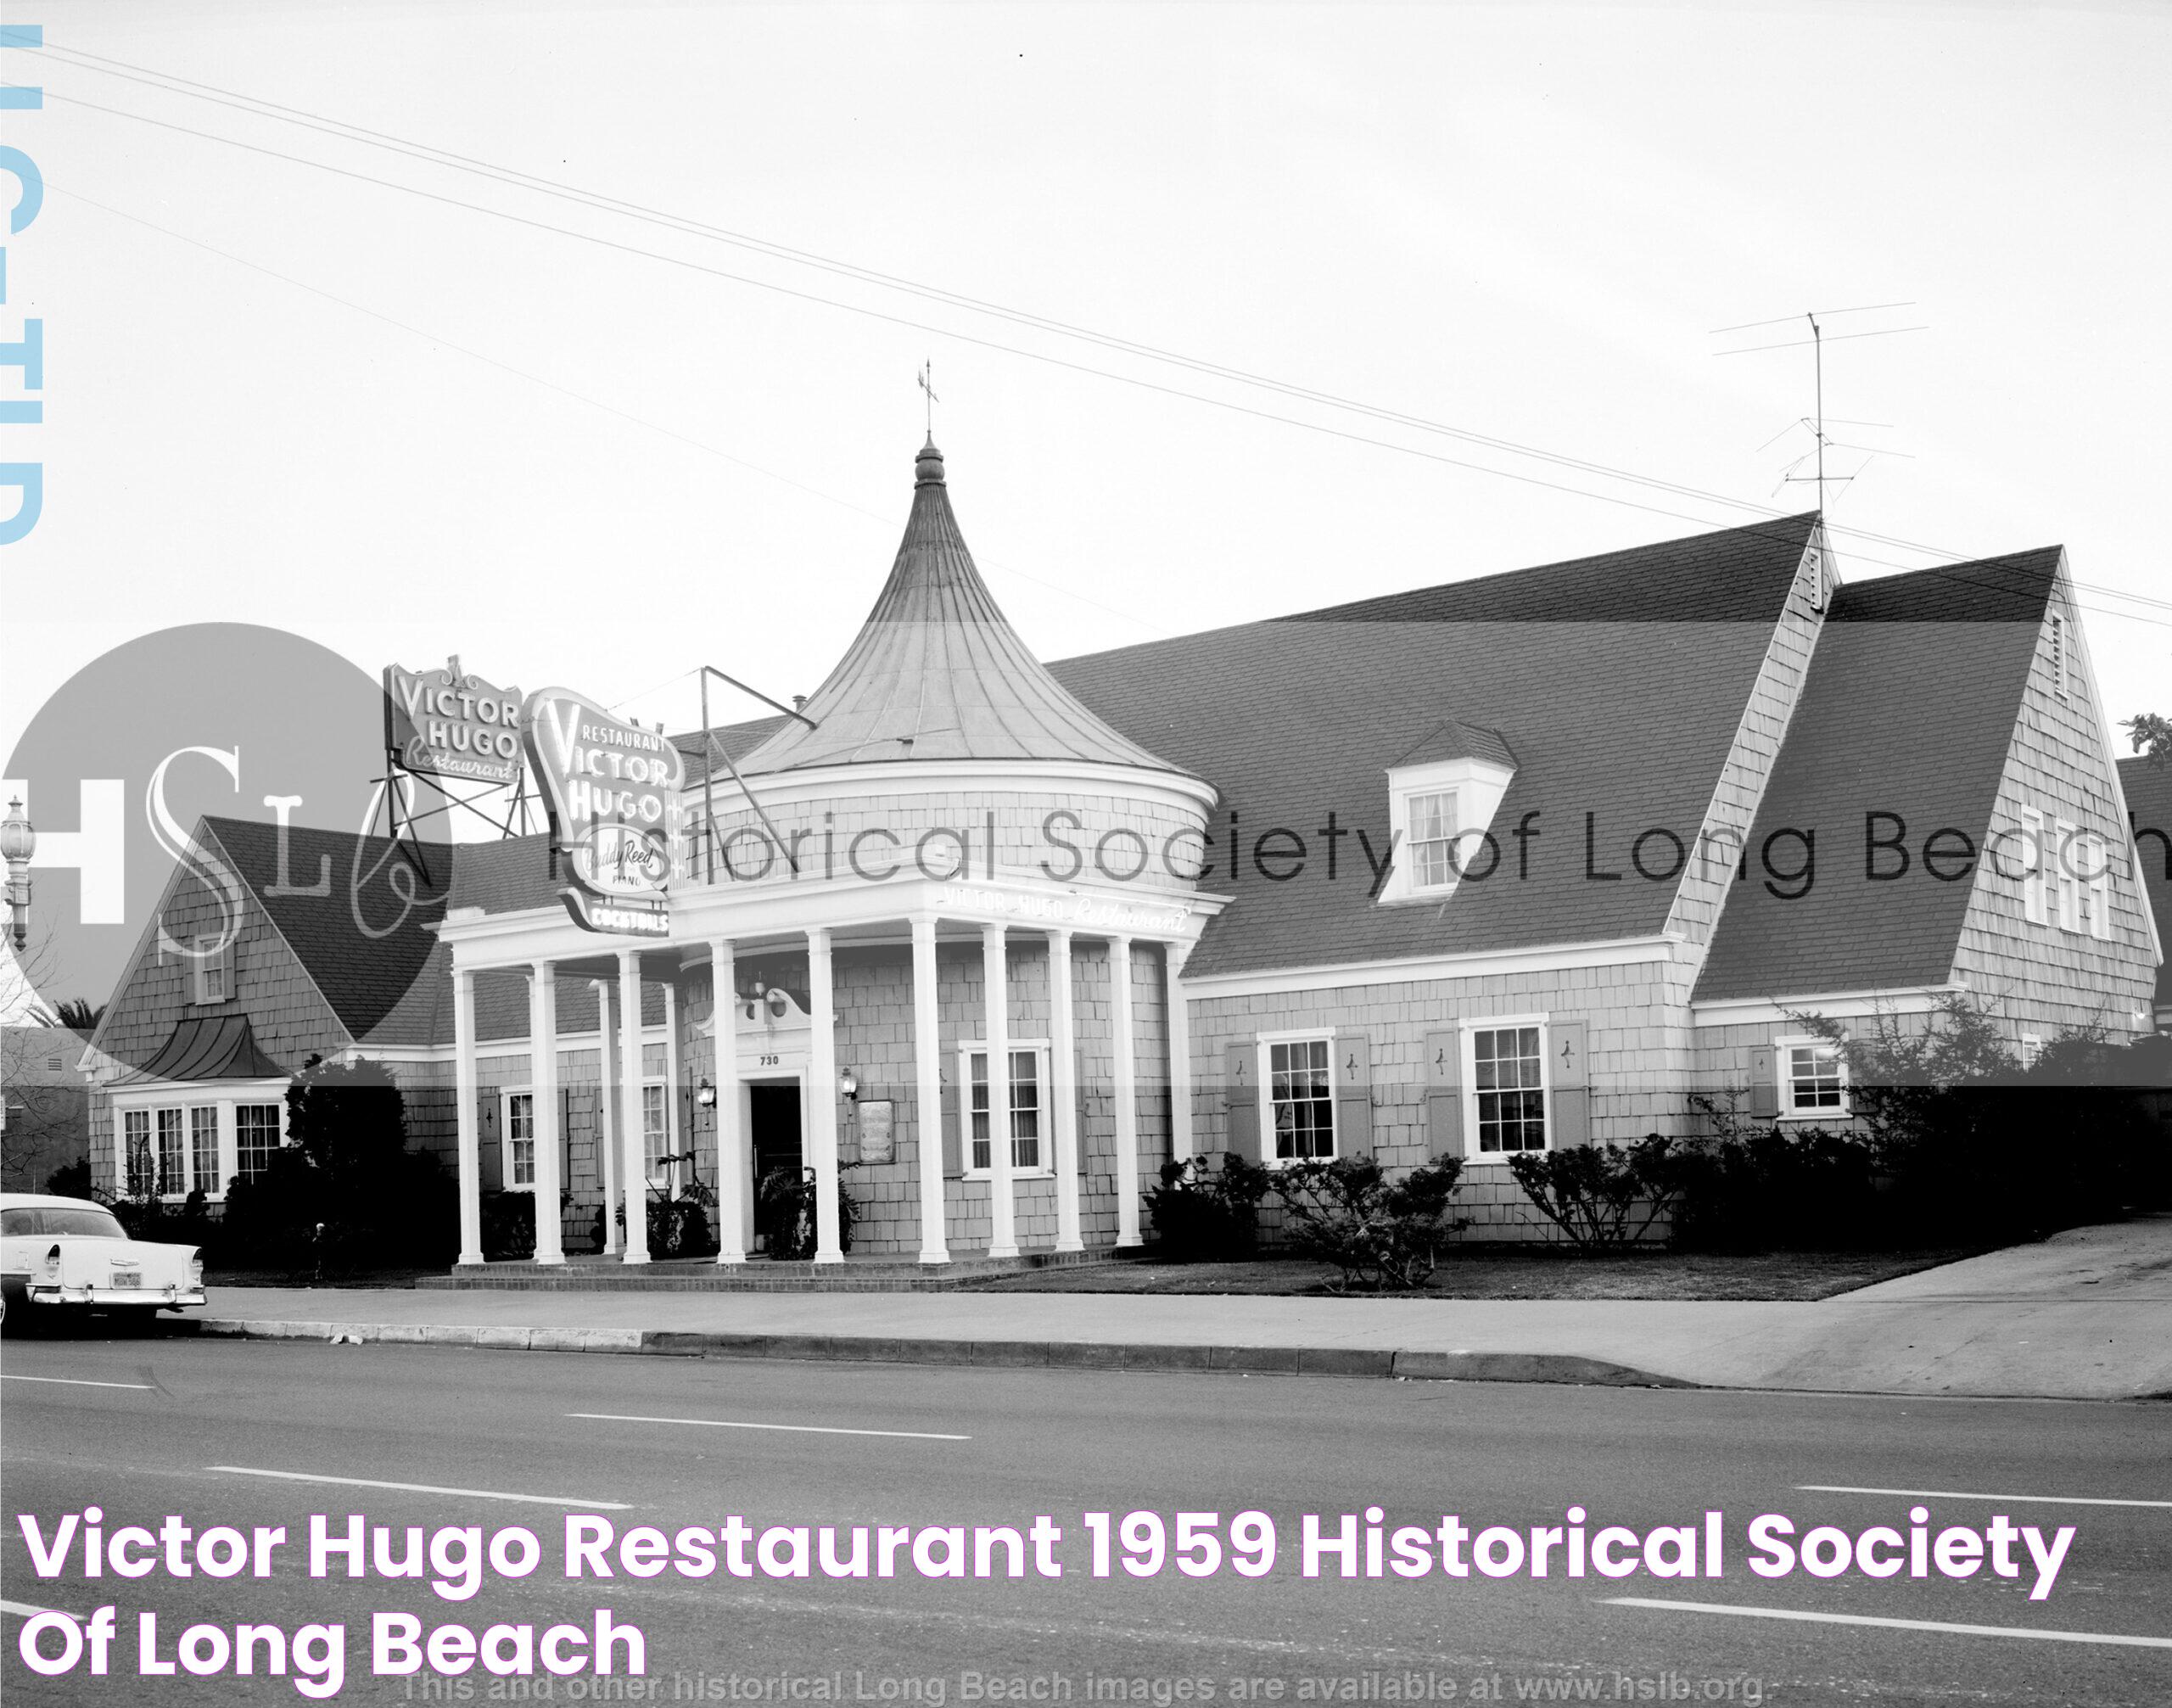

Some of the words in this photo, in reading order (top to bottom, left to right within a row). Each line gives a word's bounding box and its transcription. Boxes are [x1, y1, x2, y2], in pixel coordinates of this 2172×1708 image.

[398, 675, 519, 730] VICTOR
[405, 735, 518, 780] Restaurant
[428, 720, 518, 759] HUGO
[546, 698, 669, 788] VICTOR
[582, 724, 666, 753] RESTAURANT
[568, 779, 662, 824] HUGO
[613, 875, 641, 887] PIANO
[591, 907, 669, 932] COCKTAILS
[943, 887, 1005, 911] VICTOR
[1018, 894, 1063, 918] HUGO
[1072, 898, 1188, 932] Restaurant
[759, 1056, 780, 1066] 730
